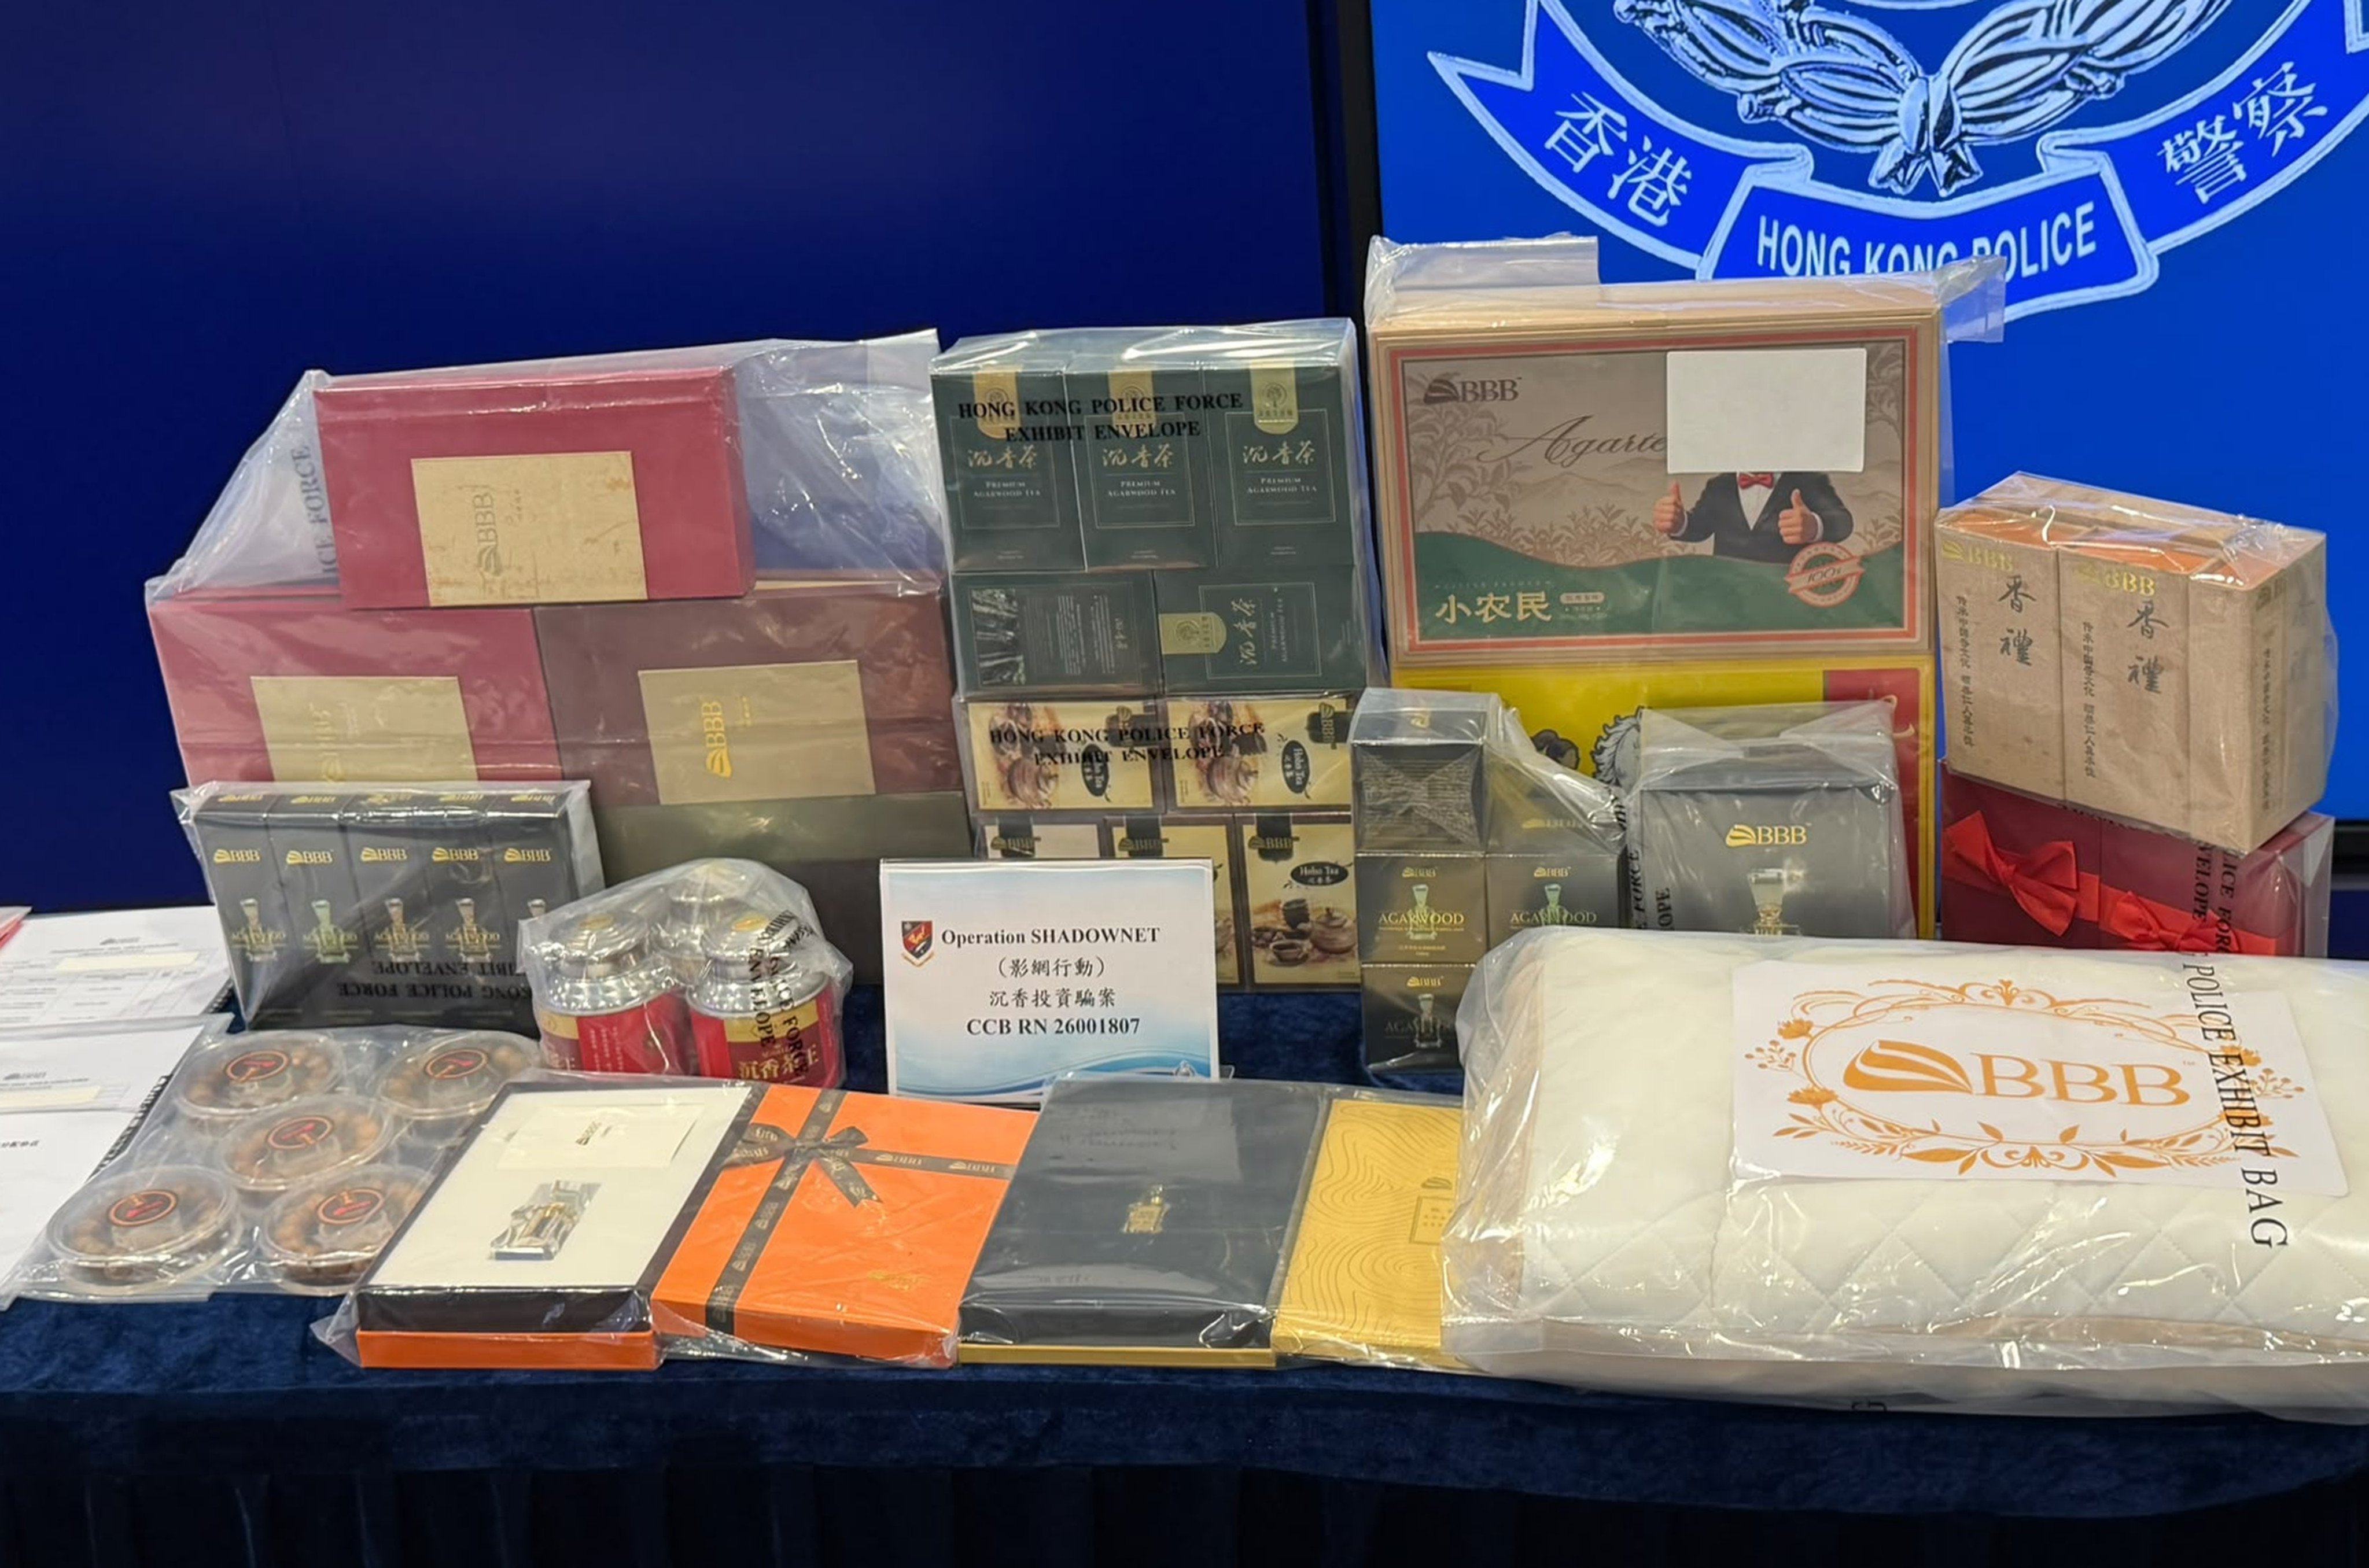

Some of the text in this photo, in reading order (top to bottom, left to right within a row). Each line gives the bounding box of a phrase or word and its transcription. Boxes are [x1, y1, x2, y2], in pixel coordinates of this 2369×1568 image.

[2156, 61, 2328, 206] 警察
[1544, 90, 1694, 229] 香港
[1756, 215, 1851, 277] HONG
[1458, 379, 1519, 403] BBB
[959, 401, 1015, 419] HONG
[1025, 399, 1081, 416] KONG
[1092, 396, 1166, 414] POLICE
[1174, 393, 1243, 410] FORCE
[1005, 420, 1200, 442] EXHIBIT ENVELOPE
[292, 445, 328, 523] FORCE
[472, 492, 498, 543] BBB
[1966, 547, 2013, 572] BBB
[2104, 569, 2156, 597] BBB
[1435, 591, 1552, 623] 小农民
[702, 701, 726, 747] BBB
[990, 722, 1265, 744] HONG KONG POLICE FORCE
[1122, 744, 1225, 763] ENVELOPE
[1756, 825, 1807, 844] BBB
[231, 850, 260, 862] BBB
[304, 851, 333, 864] BBB
[380, 848, 407, 861] BBB
[451, 848, 478, 861] BBB
[522, 849, 550, 861] BBB
[1414, 868, 1436, 877] BBB
[1546, 868, 1568, 877] BBB
[941, 926, 1160, 947] Operation SHADOWNET
[373, 961, 467, 976] ENVELOPE
[998, 956, 1106, 978] （影網行動）
[338, 984, 398, 998] FORCE
[406, 983, 473, 998] POLICE
[989, 987, 1117, 1009] 沉香投資騙案
[967, 1017, 1140, 1035] CCB RN 26001807
[1969, 1052, 2191, 1107] BBB
[2183, 962, 2289, 1249] POLICE EXHIBIT BAG
